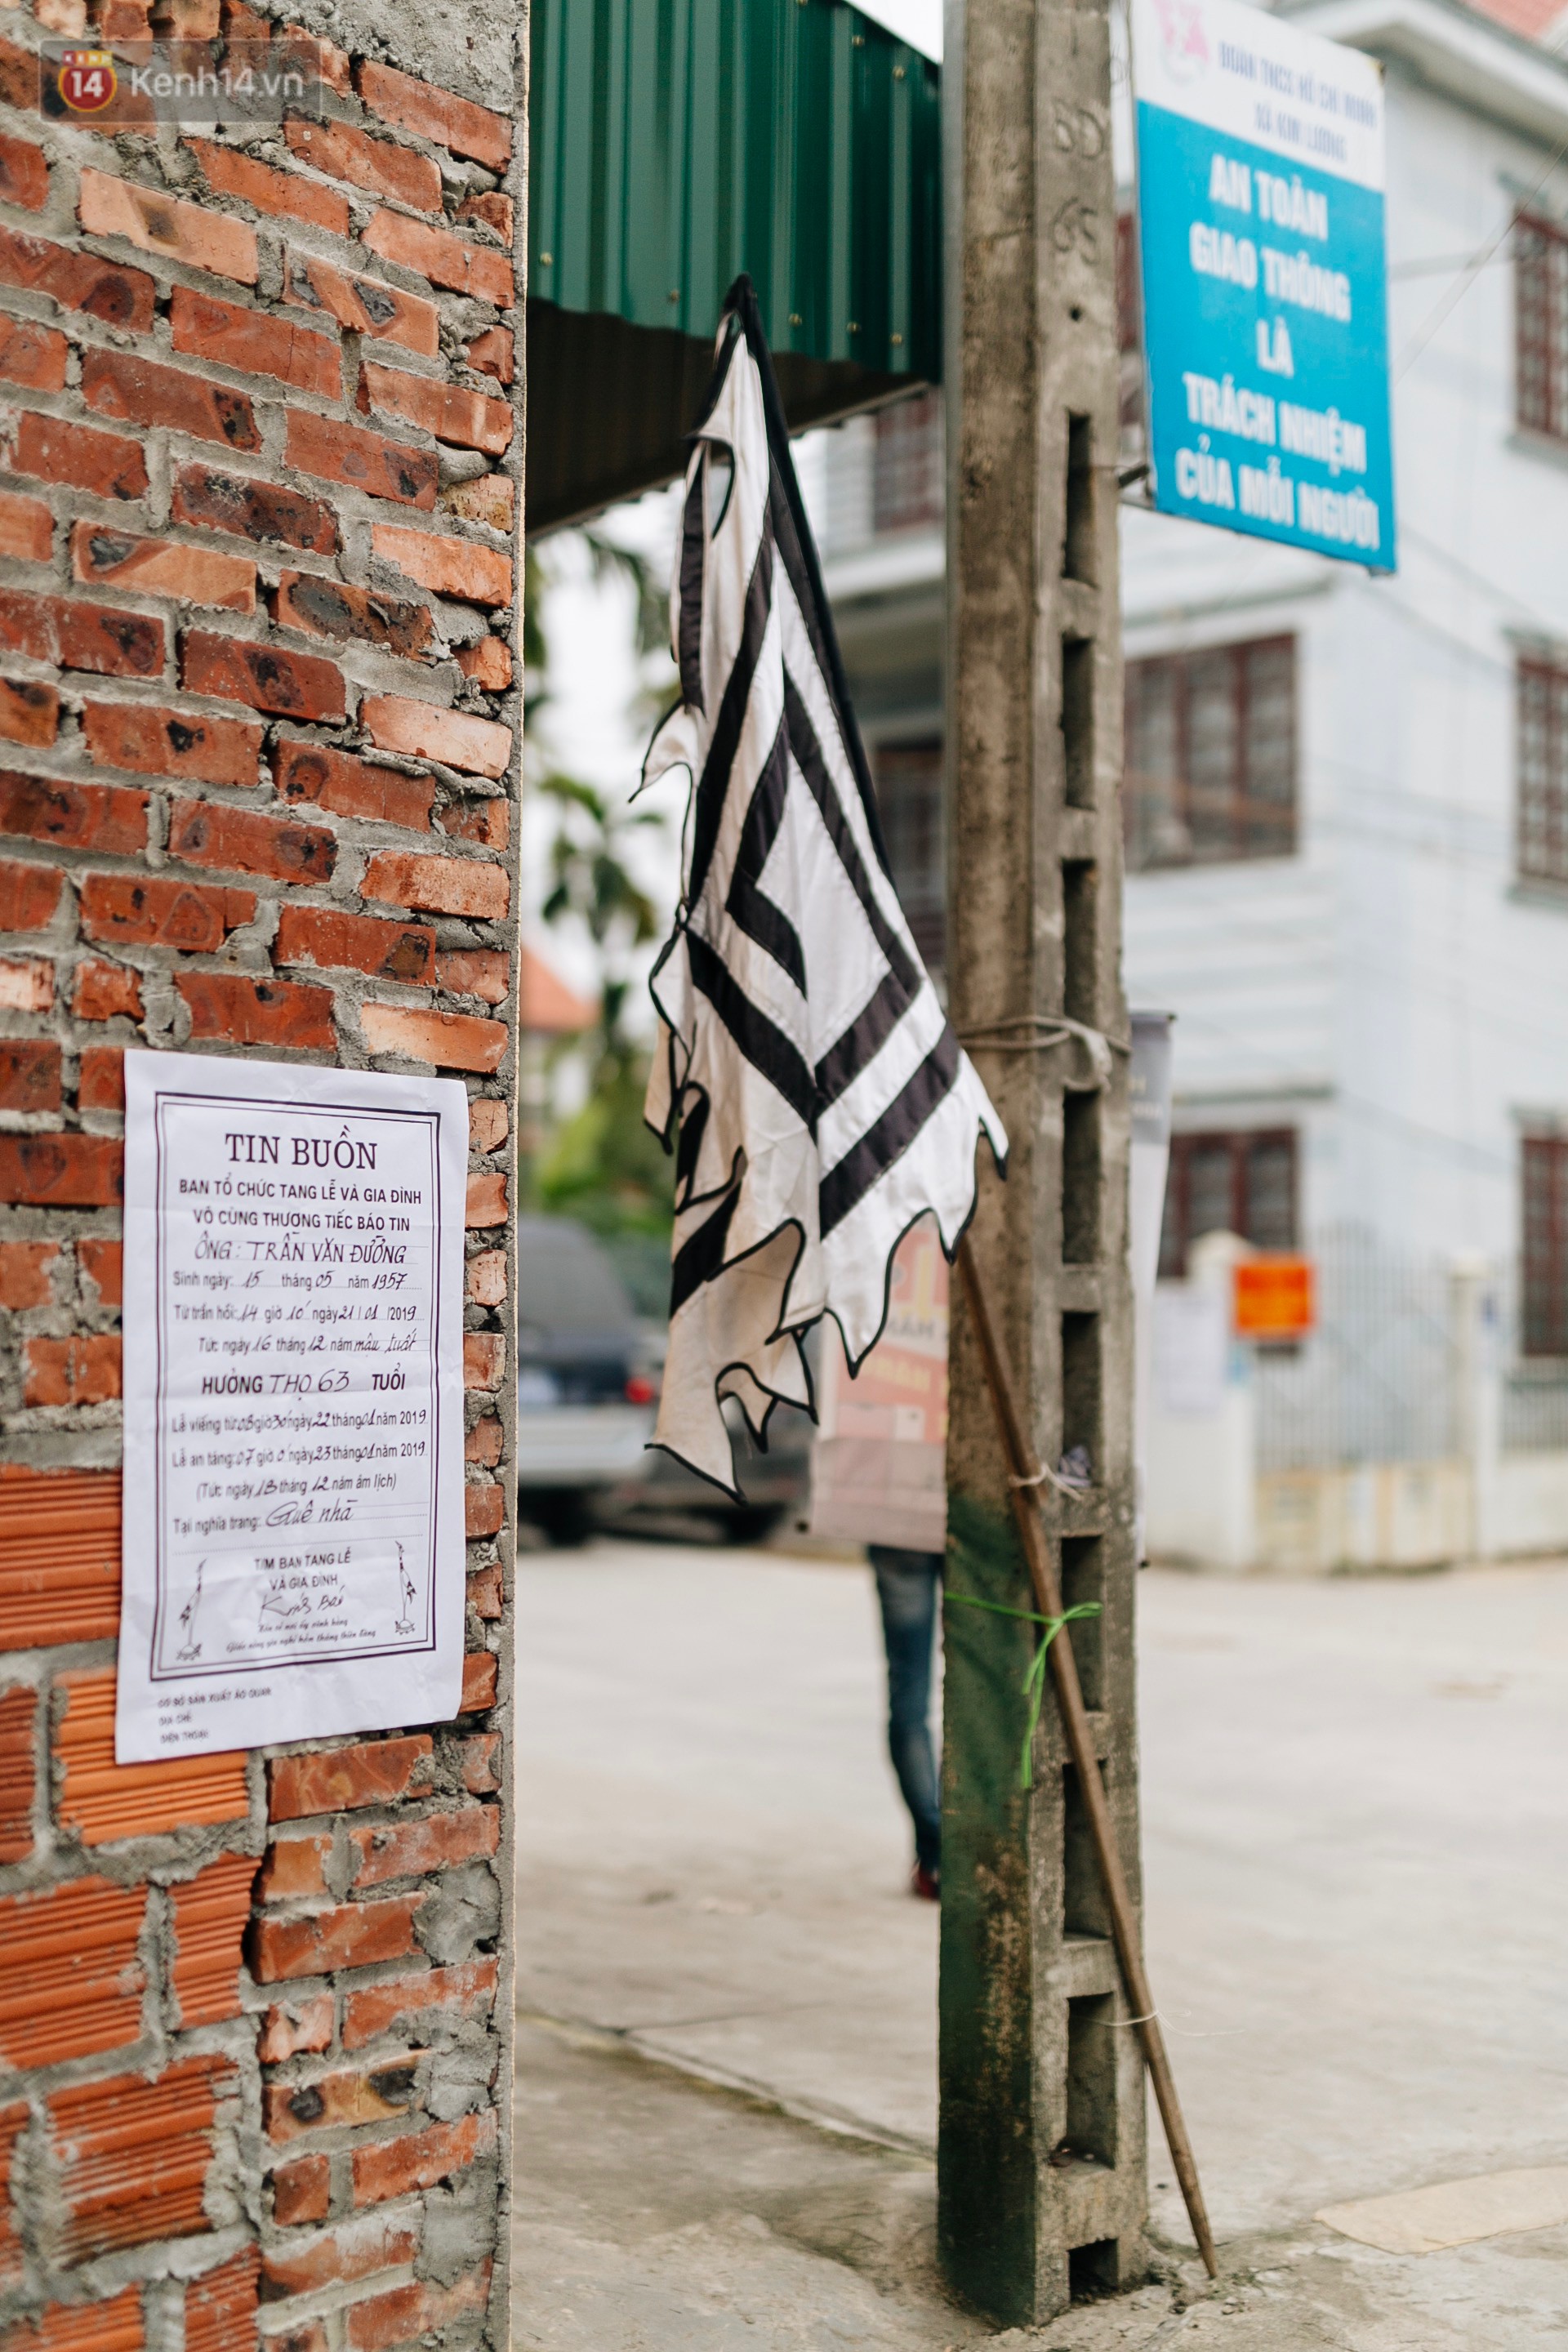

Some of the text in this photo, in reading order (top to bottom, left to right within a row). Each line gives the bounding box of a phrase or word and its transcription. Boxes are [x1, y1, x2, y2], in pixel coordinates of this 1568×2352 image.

[1209, 153, 1329, 243] AN TOÀN
[1189, 221, 1352, 323] GIAO THÔNG
[1255, 314, 1294, 379] LÀ
[1182, 371, 1367, 477] TRÁCH NHIỆM
[1174, 433, 1236, 510] CỦA
[1297, 481, 1380, 551] NGƯỜI
[225, 1125, 377, 1169] TIN BUỒN
[179, 1172, 421, 1204] BAN TỔ CHỨC TANG LỄ VÀ GIA ĐÌNH
[194, 1205, 410, 1232] VÔ CÙNG THƯƠNG TIẾC BÁO TIN
[313, 1237, 345, 1262] VĂN
[173, 1271, 200, 1286] Sinh
[243, 1270, 265, 1288] 15
[282, 1273, 312, 1291] tháng
[315, 1270, 336, 1288] 05
[348, 1275, 369, 1289] năm
[372, 1272, 408, 1290] 1957
[173, 1304, 189, 1320] Từ
[192, 1302, 214, 1320] trần
[239, 1303, 258, 1322] 14
[265, 1305, 282, 1324] giờ
[312, 1305, 338, 1324] ngày
[338, 1305, 354, 1320] 21
[364, 1303, 379, 1321] 01
[199, 1336, 218, 1352] Tức
[222, 1337, 251, 1356] ngày
[252, 1334, 272, 1352] 16
[276, 1336, 306, 1356] tháng
[308, 1334, 327, 1352] 12
[330, 1338, 352, 1352] năm
[202, 1362, 406, 1401] HƯỞNG THỌ 63 TUỔI
[172, 1413, 186, 1432] Lễ
[189, 1414, 221, 1435] viếng
[254, 1414, 272, 1433] giờ
[288, 1413, 313, 1431] ngày
[312, 1411, 330, 1428] 22
[332, 1412, 362, 1430] tháng
[360, 1409, 376, 1426] 01
[376, 1411, 397, 1426] năm
[400, 1409, 426, 1425] 2019
[172, 1447, 186, 1468] Lễ
[189, 1454, 204, 1467] an
[256, 1448, 274, 1468] giờ
[289, 1446, 314, 1465] ngày
[313, 1445, 331, 1461] 23
[332, 1445, 362, 1463] tháng
[359, 1442, 376, 1459] 01
[376, 1445, 397, 1458] năm
[401, 1441, 425, 1457] 2019
[225, 1480, 254, 1500] ngày
[279, 1477, 307, 1495] tháng
[312, 1476, 330, 1492] 12
[332, 1475, 353, 1490] năm
[356, 1474, 370, 1489] âm
[373, 1472, 397, 1491] lịch)
[279, 1556, 301, 1569] BAN
[305, 1553, 335, 1566] TANG
[337, 1547, 351, 1564] LỄ
[269, 1571, 338, 1591] VÀ GIA ĐÌNH
